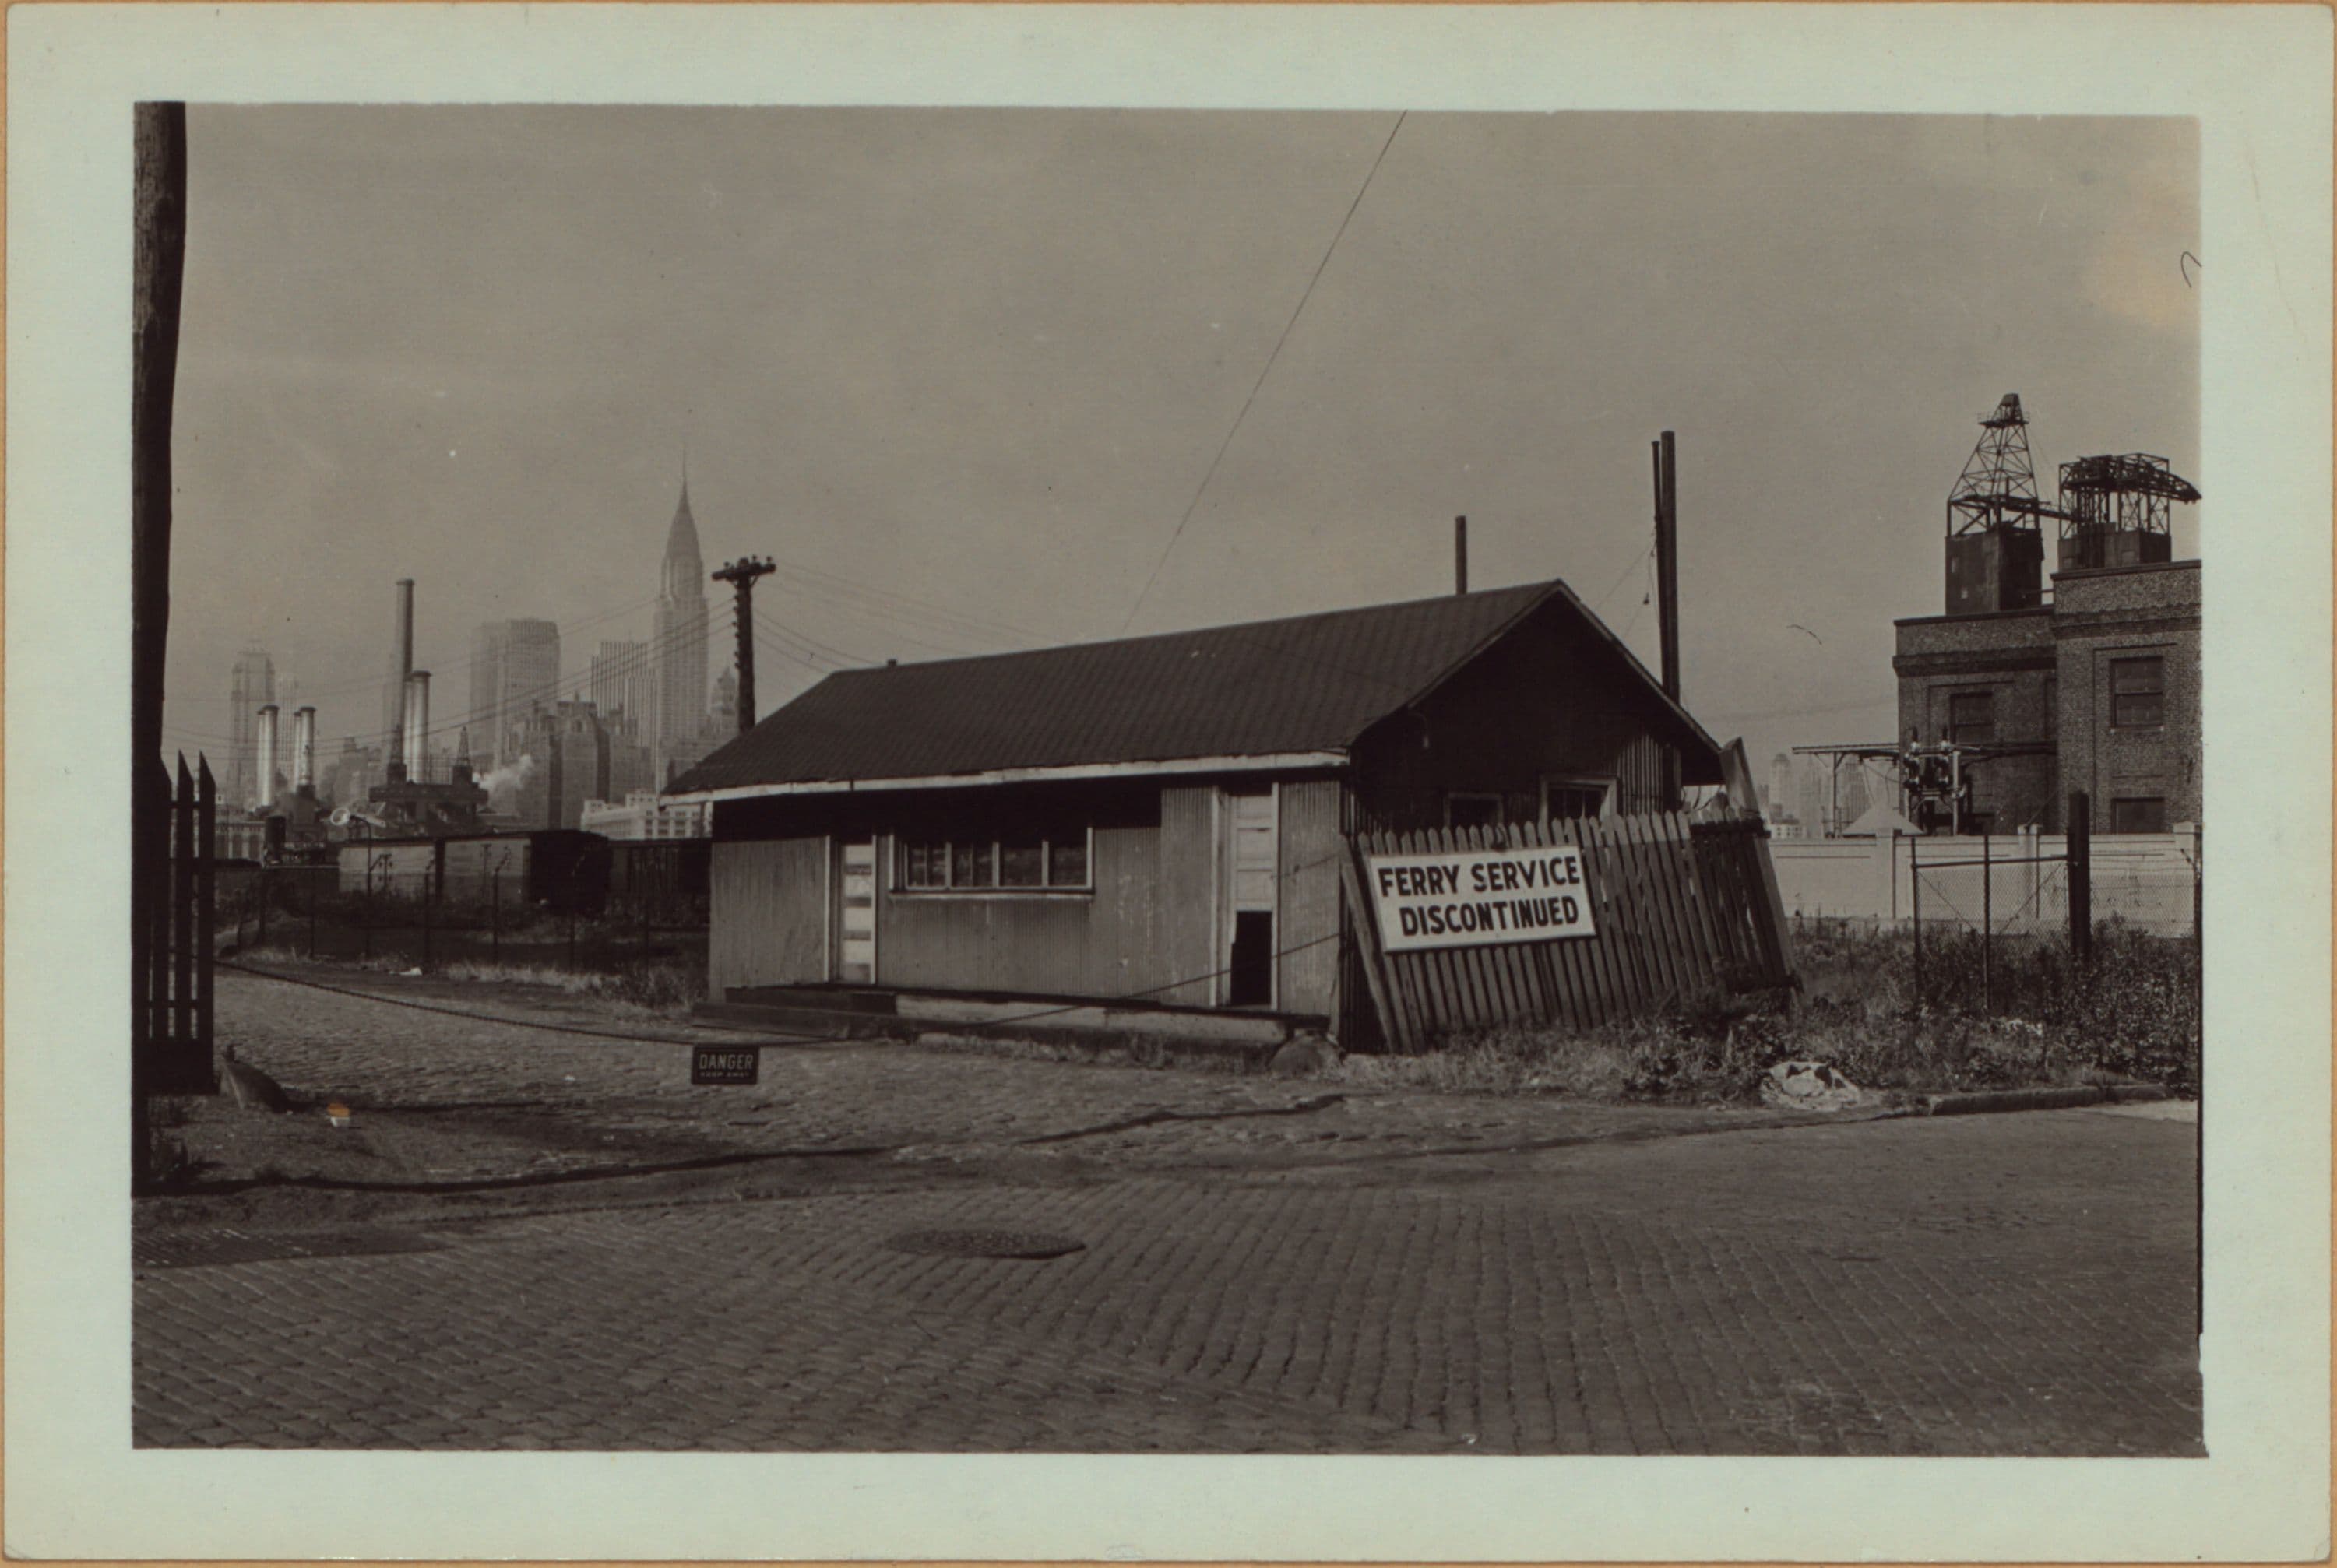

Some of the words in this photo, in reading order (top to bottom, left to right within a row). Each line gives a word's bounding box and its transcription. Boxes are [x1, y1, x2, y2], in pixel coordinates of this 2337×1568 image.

[1378, 864, 1460, 897] FERRY
[1470, 856, 1580, 892] SERVICE
[1399, 896, 1579, 936] DISCONTINUED
[699, 1054, 754, 1070] DANGER
